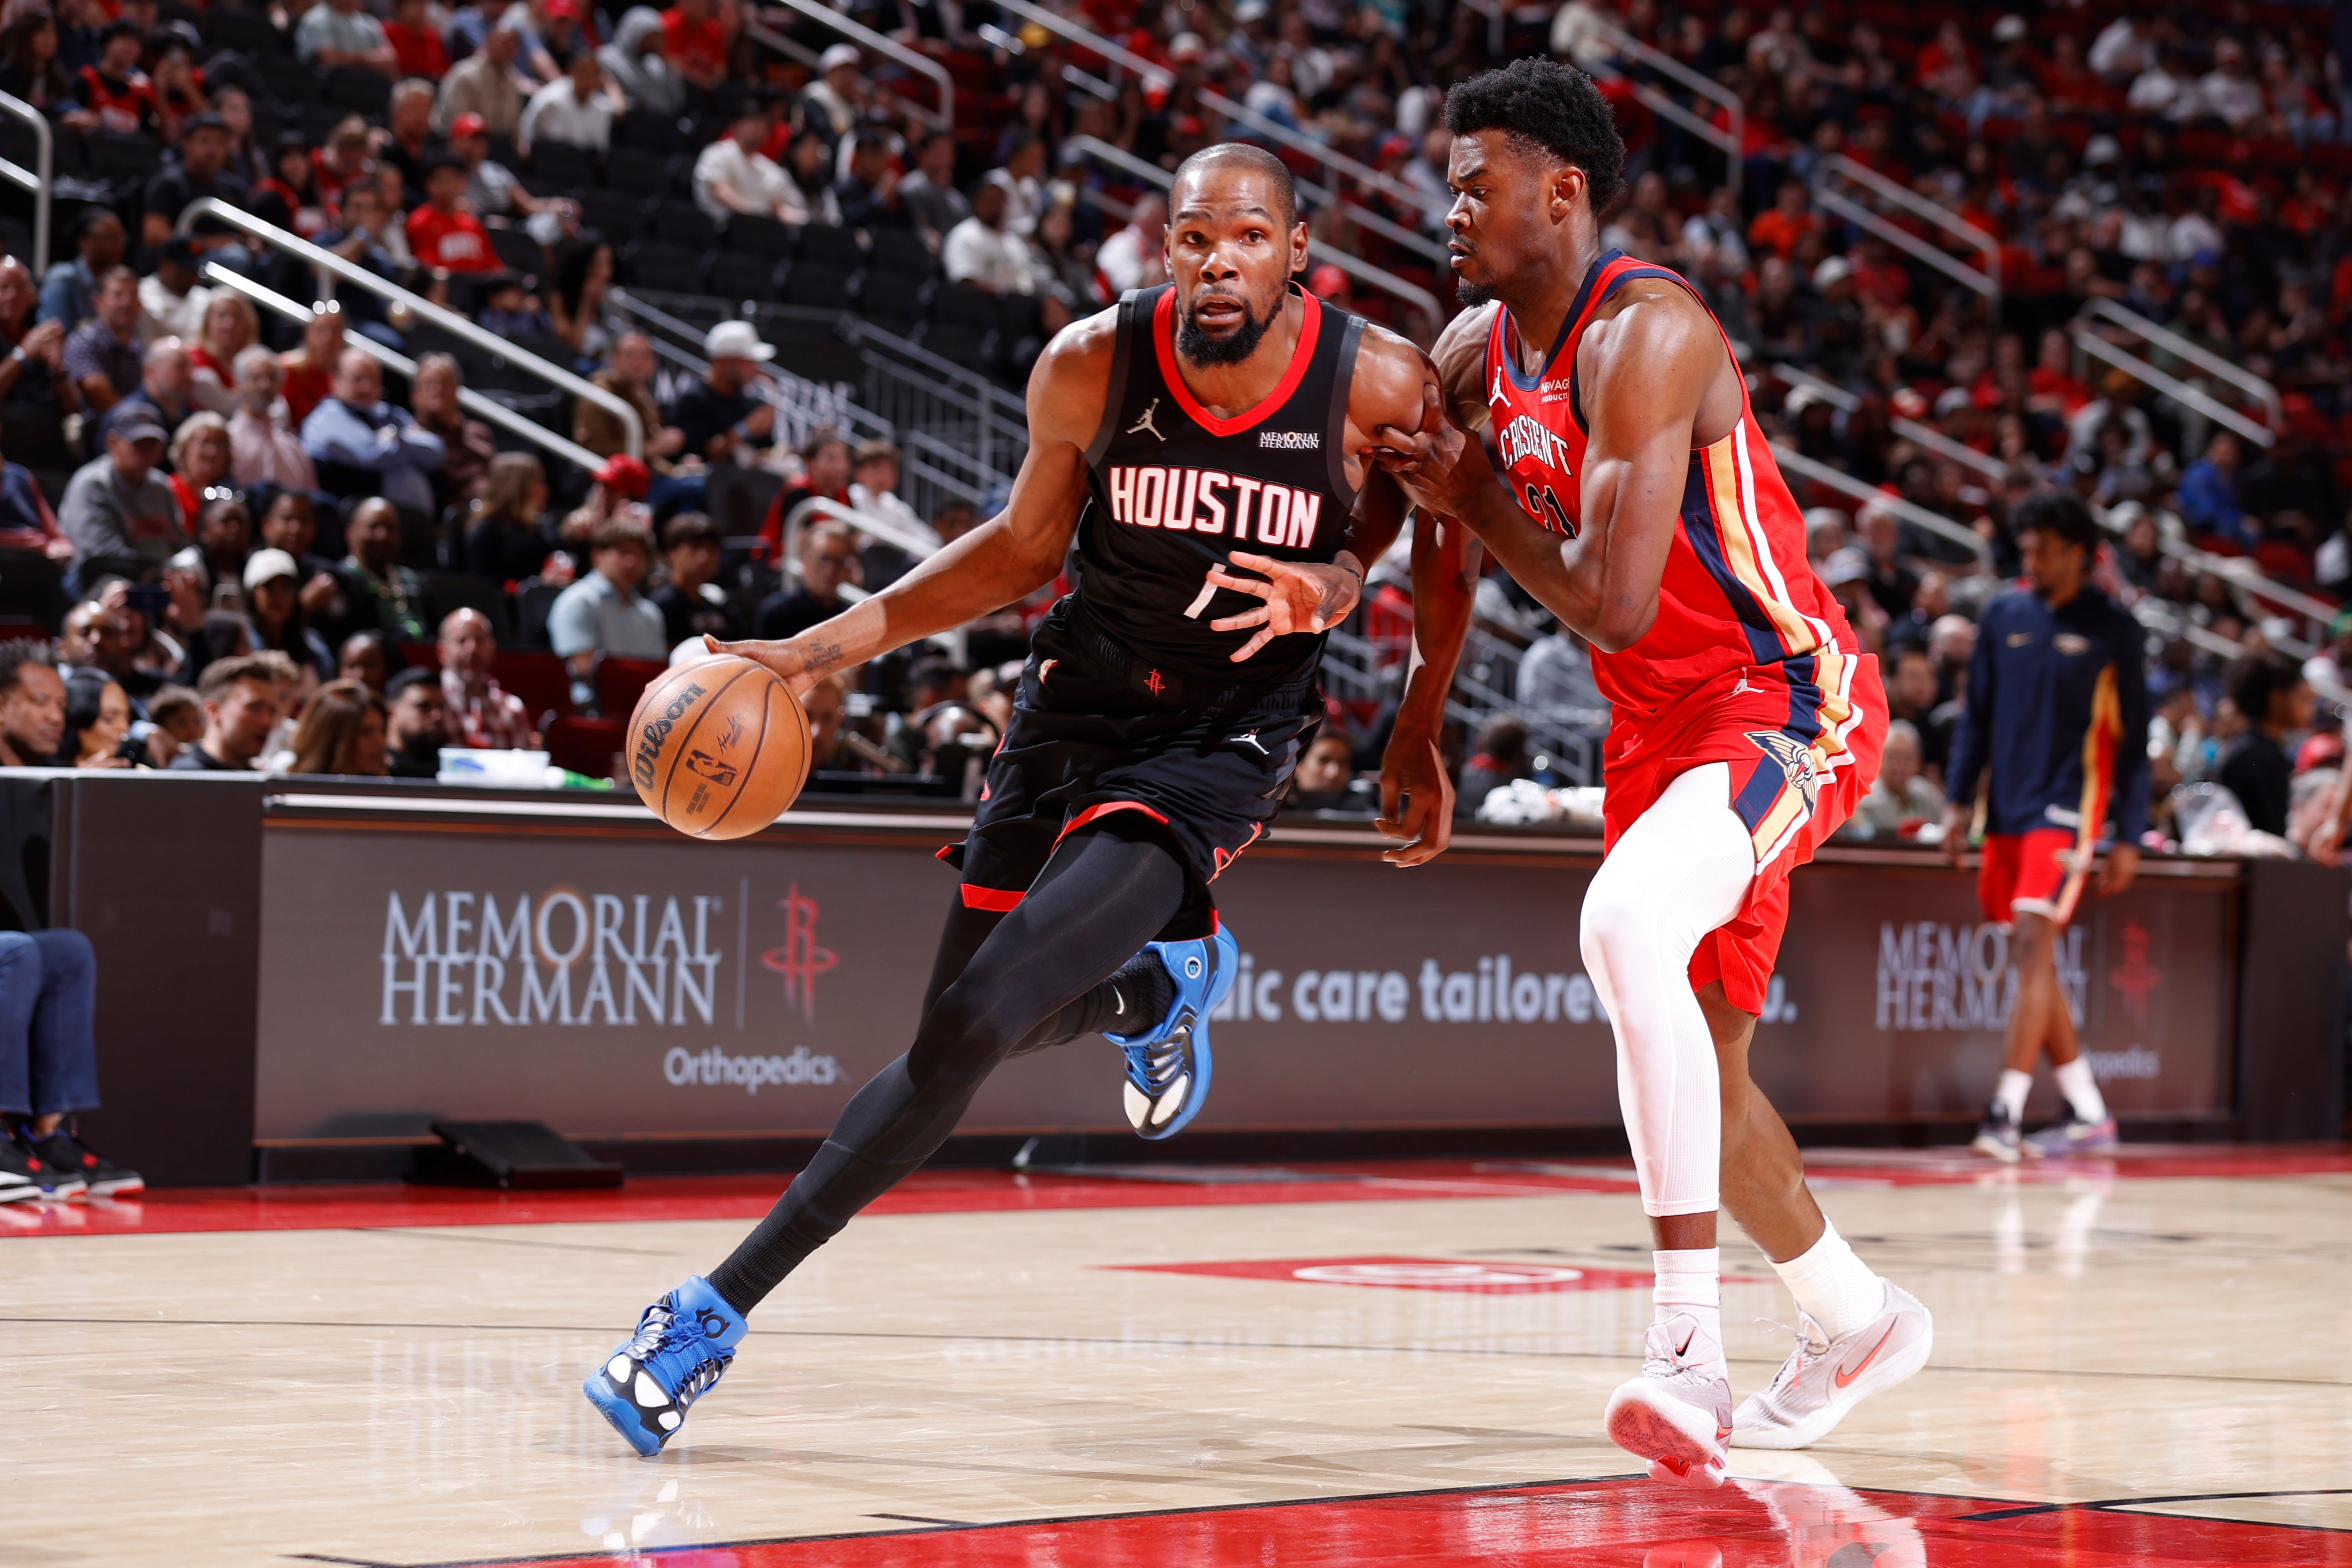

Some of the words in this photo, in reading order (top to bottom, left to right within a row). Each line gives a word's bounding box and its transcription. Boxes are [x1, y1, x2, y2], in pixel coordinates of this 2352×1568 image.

[1260, 431, 1320, 443] MEMORIAL
[1260, 439, 1319, 449] HERMANN
[1109, 465, 1323, 549] HOUSTON
[635, 683, 707, 792] Wilson
[381, 890, 722, 965] MEMORIAL
[379, 954, 719, 1026] HERMANN
[1292, 970, 1409, 1022] care
[664, 1046, 836, 1095] Orthopedics
